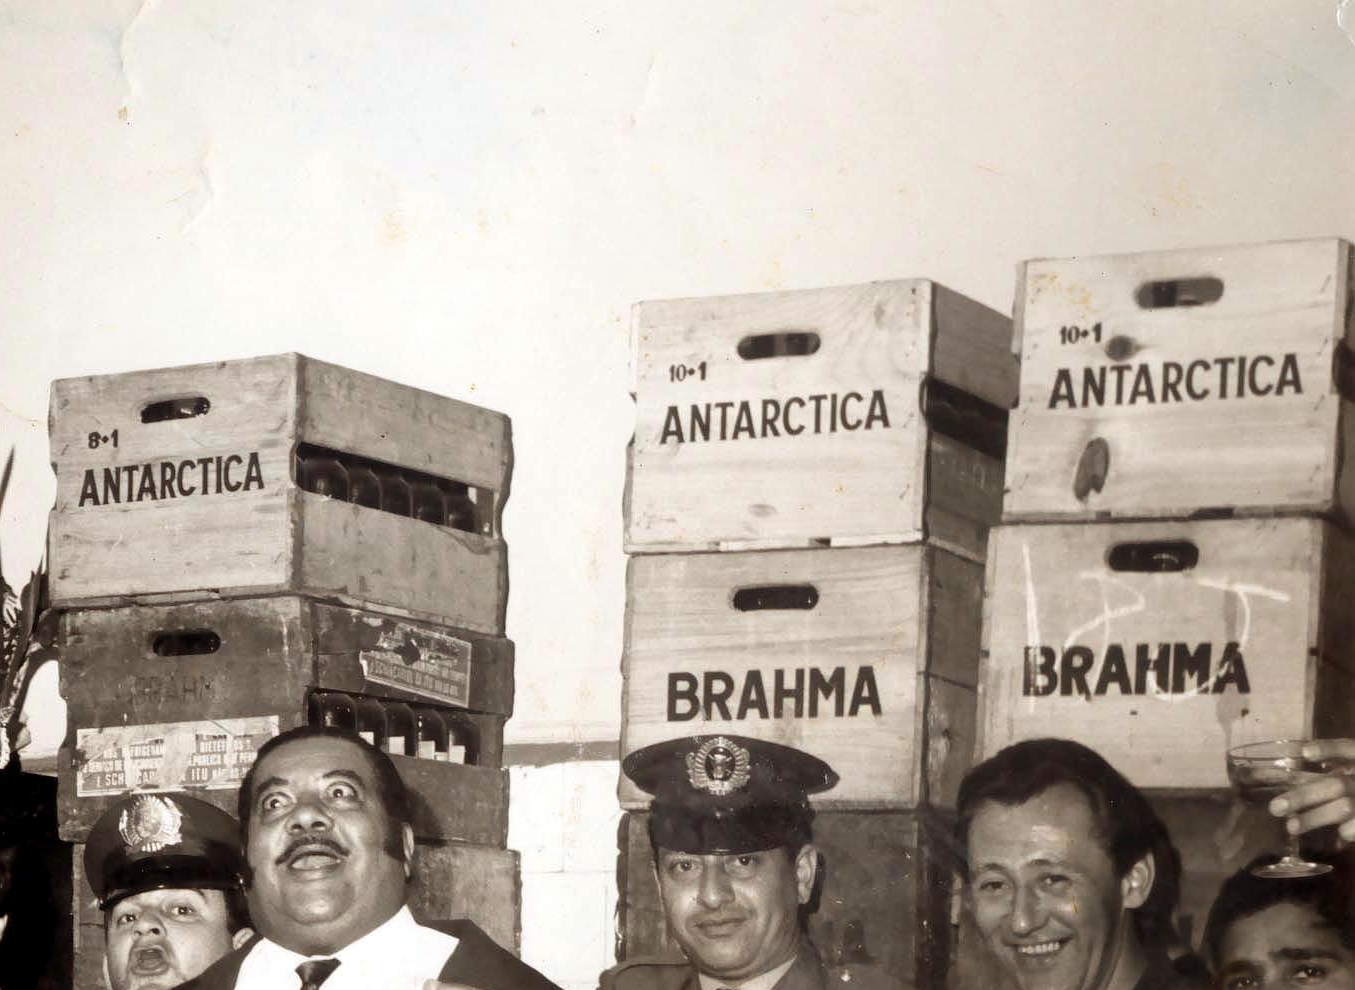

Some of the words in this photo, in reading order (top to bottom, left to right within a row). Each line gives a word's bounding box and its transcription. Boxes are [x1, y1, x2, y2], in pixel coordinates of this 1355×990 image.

[1047, 352, 1304, 409] ANTARCTICA
[659, 389, 891, 445] ANTARCTICA
[78, 452, 265, 507] ANTARCTICA
[667, 665, 883, 722] BRAHMA
[1021, 640, 1251, 698] BRAHMA
